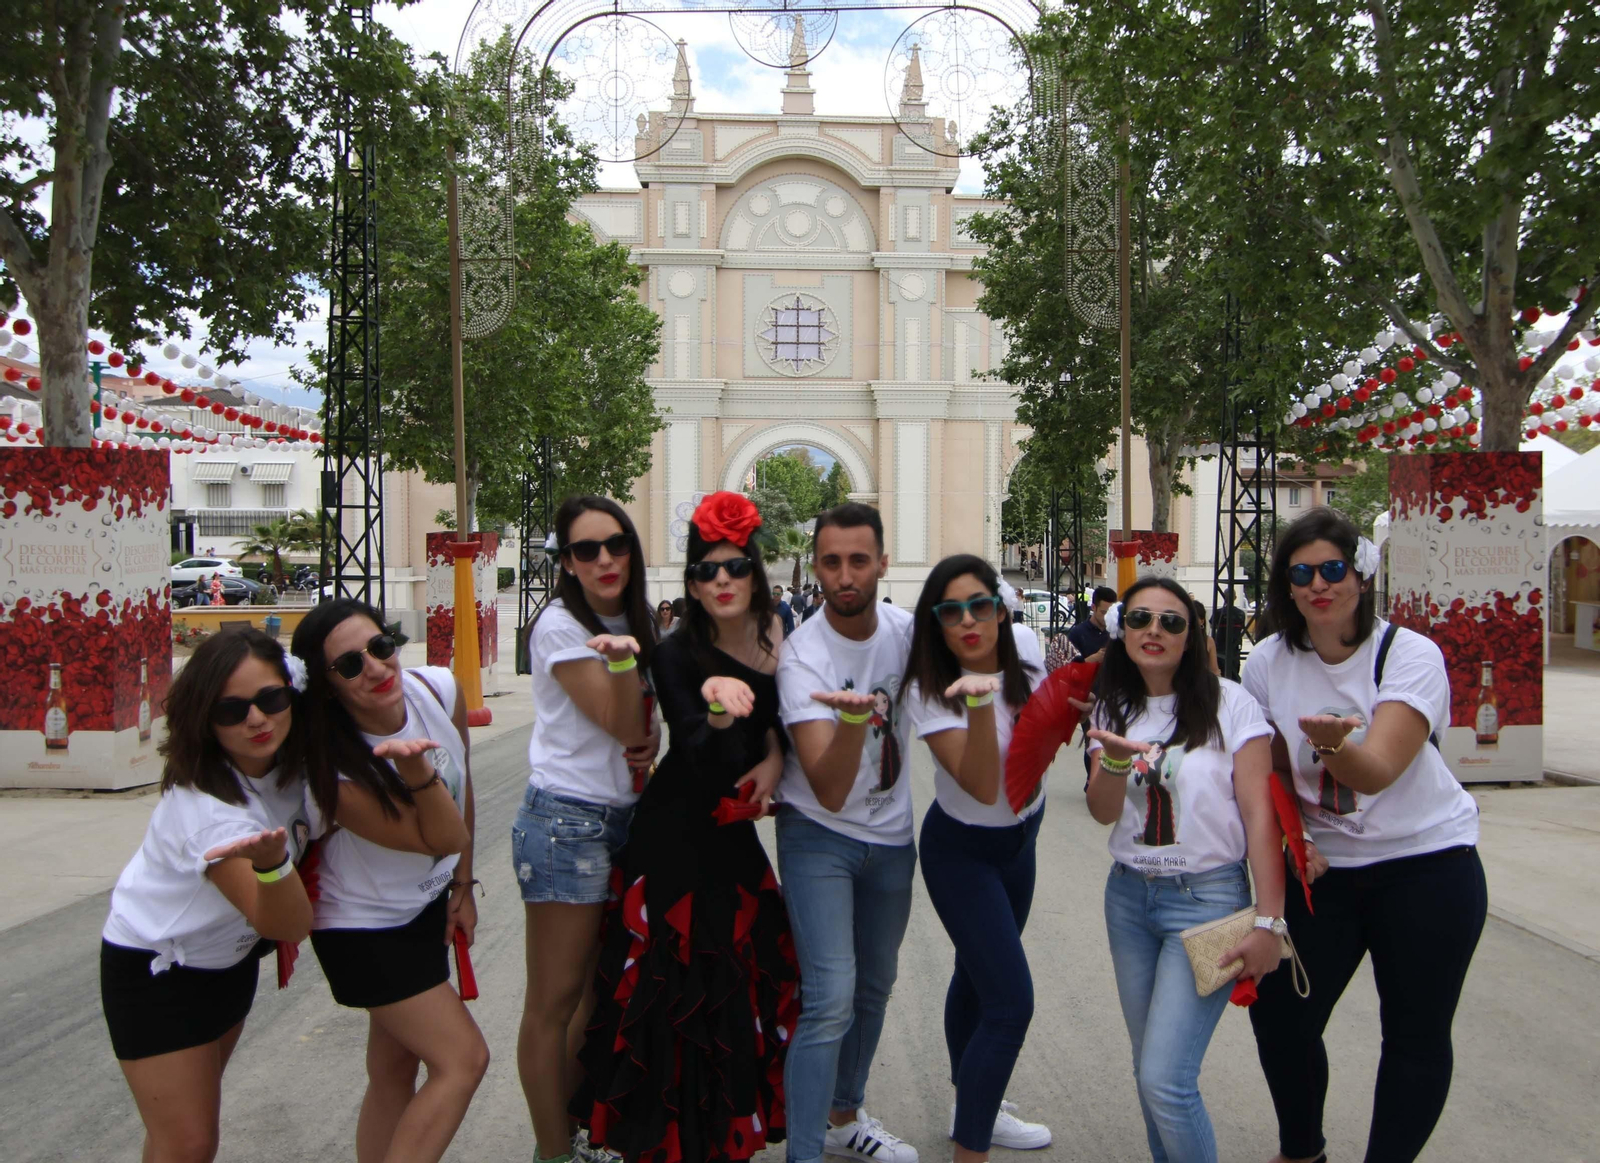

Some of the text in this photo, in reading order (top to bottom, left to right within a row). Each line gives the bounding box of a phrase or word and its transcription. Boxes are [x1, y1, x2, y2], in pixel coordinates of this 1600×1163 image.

[19, 544, 87, 555] DESCUBRE
[1454, 545, 1520, 557] DESCUBRE
[19, 555, 87, 565] EL CORPUS
[1454, 556, 1520, 567] EL CORPUS
[43, 566, 87, 575] ESPECIAL
[1163, 855, 1187, 867] MARÍA
[417, 870, 452, 893] DESPEDIDA
